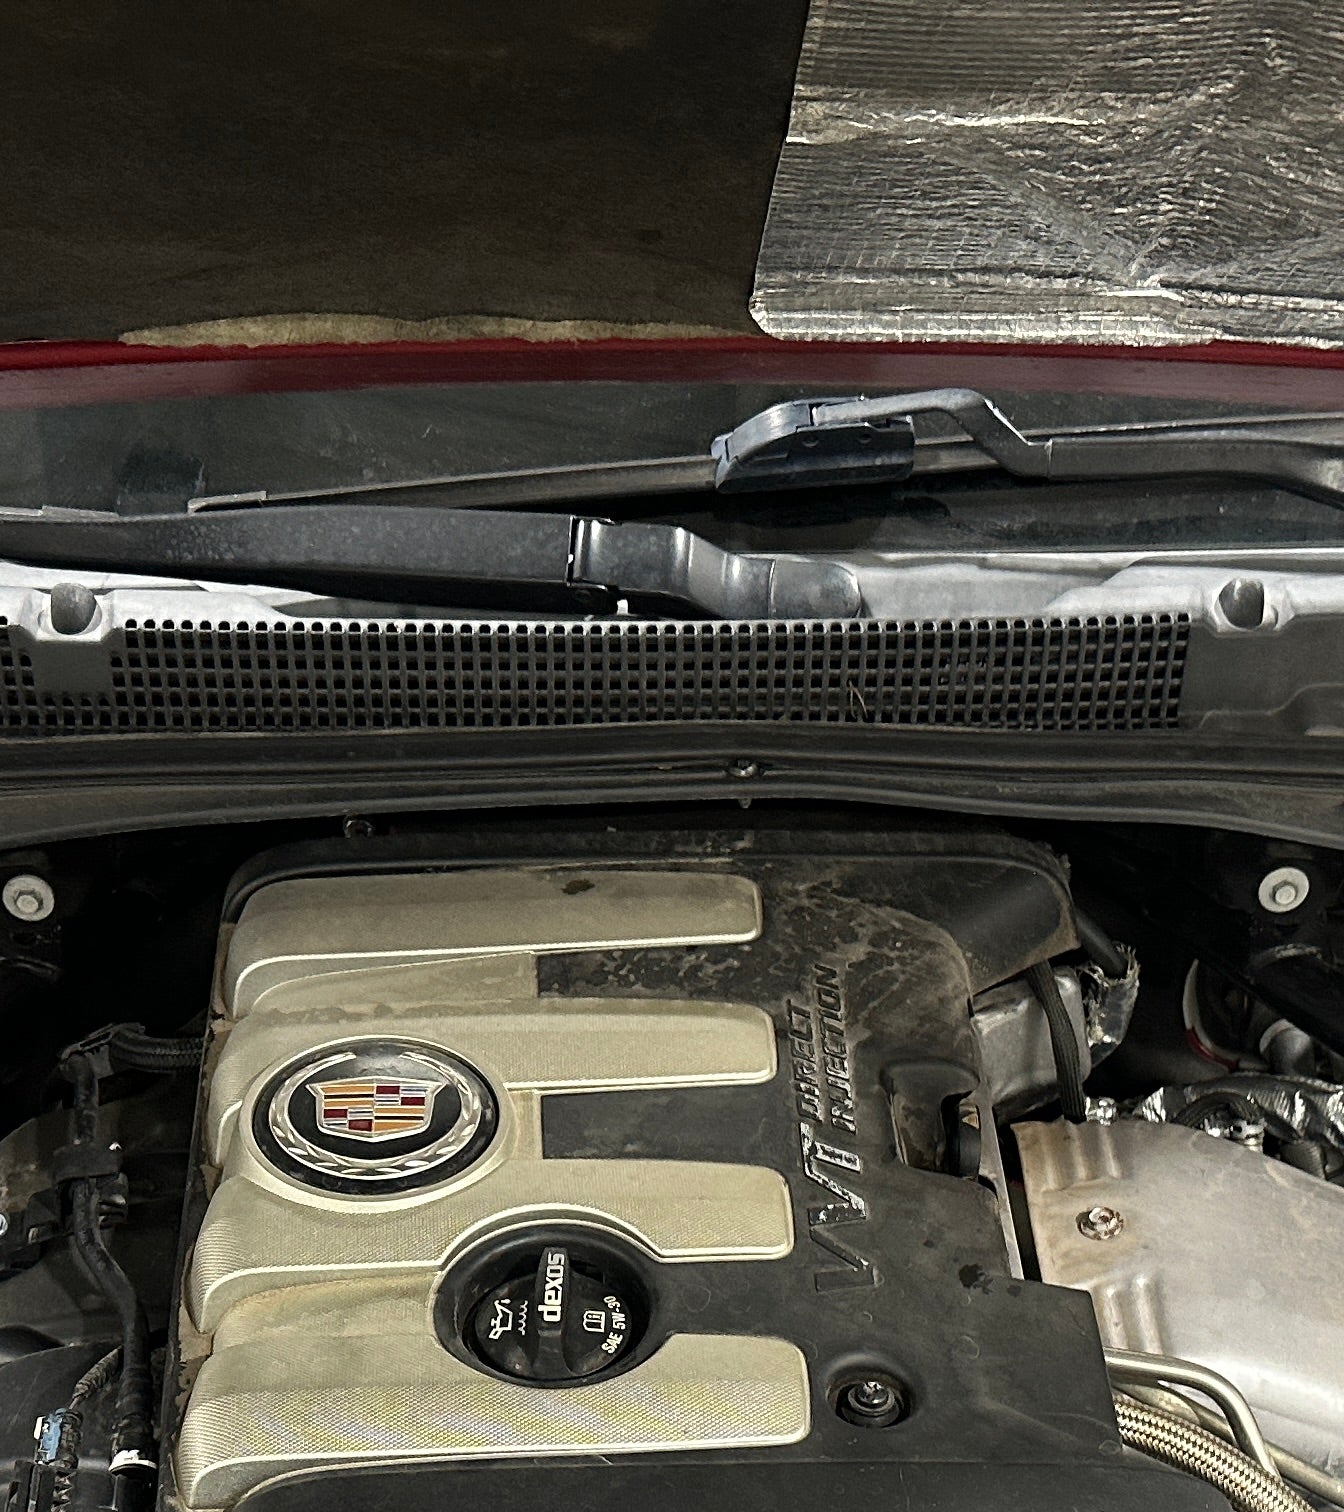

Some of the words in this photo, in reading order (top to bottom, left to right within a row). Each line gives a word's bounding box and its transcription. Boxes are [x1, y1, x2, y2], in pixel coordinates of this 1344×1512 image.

[786, 999, 823, 1123] DIRECT
[813, 962, 856, 1136] INJECTION
[799, 1119, 877, 1293] VVT
[537, 1251, 565, 1322] dexos
[603, 1295, 626, 1330] 5W-30
[601, 1331, 624, 1354] SAE
